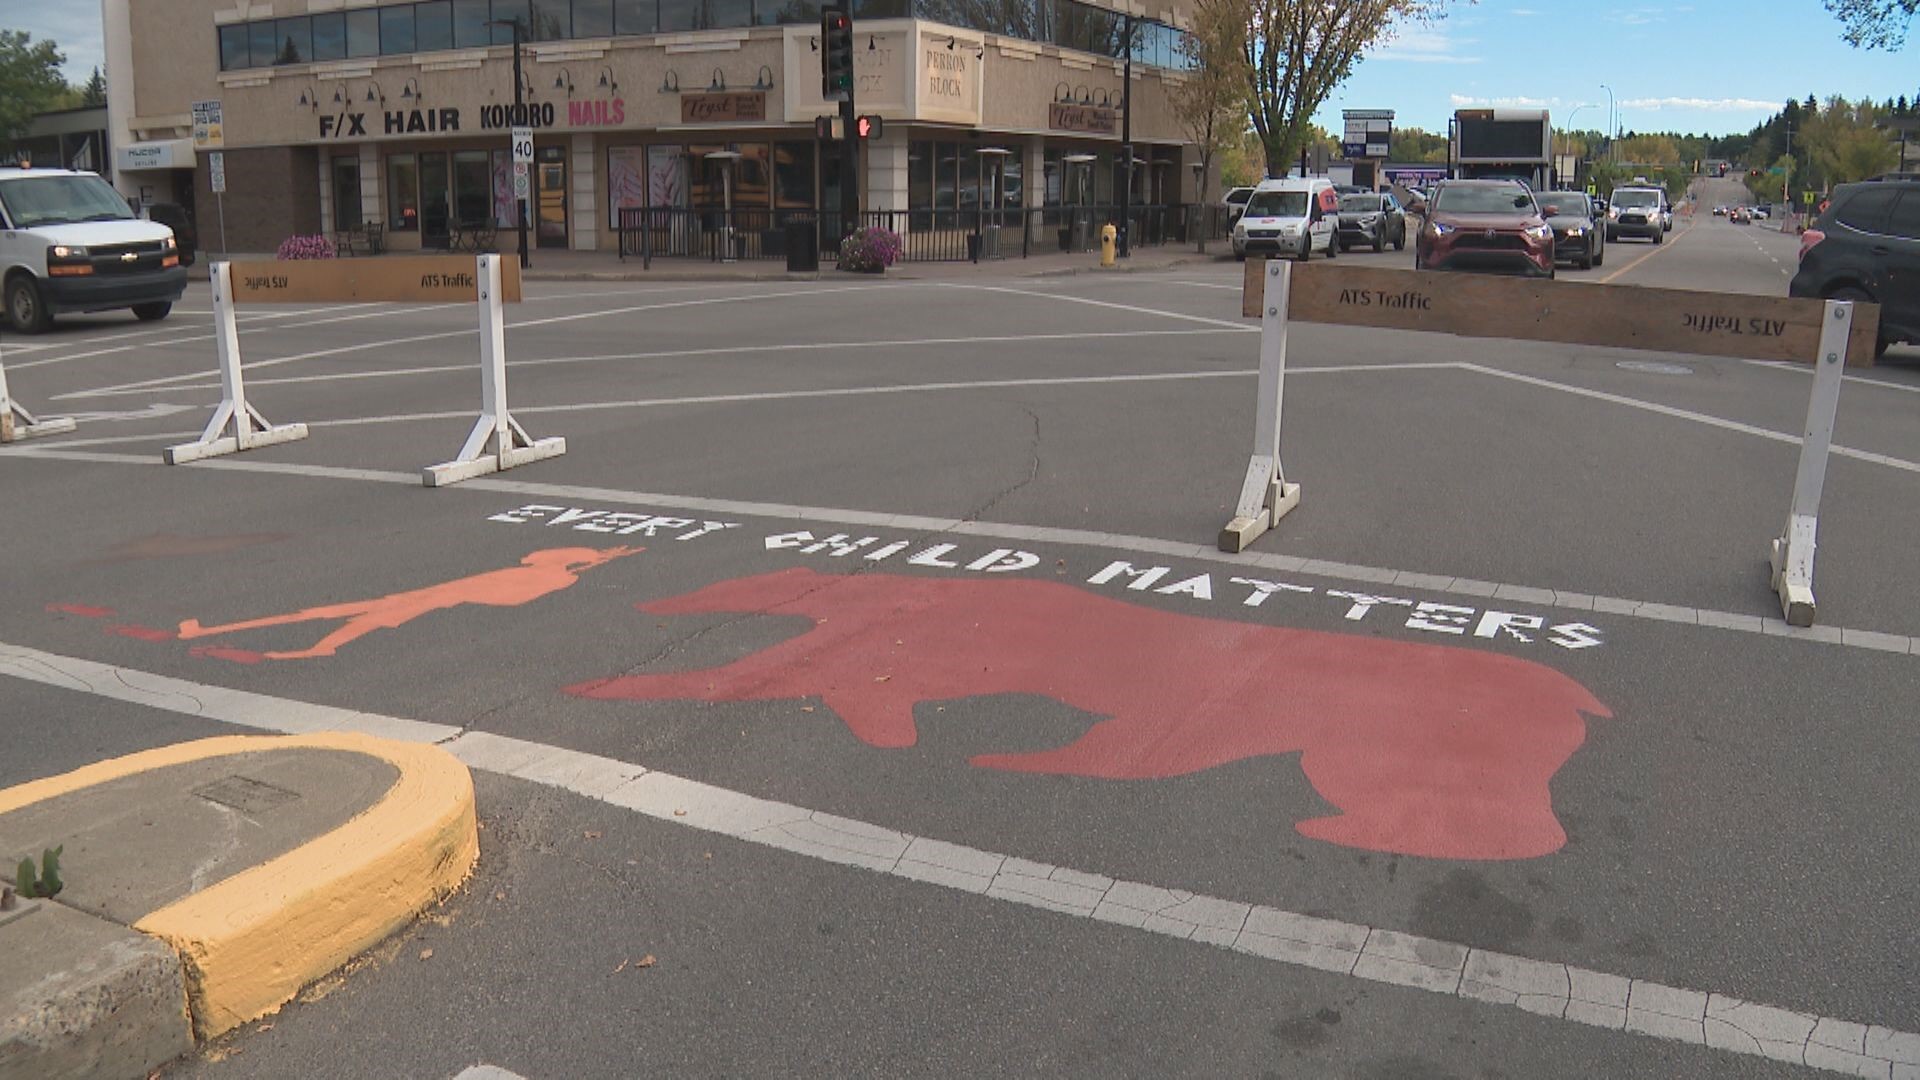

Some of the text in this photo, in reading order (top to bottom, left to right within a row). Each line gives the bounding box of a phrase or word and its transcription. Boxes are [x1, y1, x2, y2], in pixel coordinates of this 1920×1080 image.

[927, 50, 966, 72] PERRON
[930, 77, 961, 96] BLOCK
[568, 98, 624, 126] NAILS
[684, 96, 731, 119] Tryst
[319, 107, 460, 138] F/X HAIR
[515, 141, 532, 158] 40
[244, 275, 288, 290] ATS Traffic
[421, 272, 473, 288] ATS Traffic
[1339, 288, 1432, 310] ATS Traffic
[1681, 313, 1786, 336] ATS Traffic
[487, 504, 1603, 650] EVERY CHILD MATTERS
